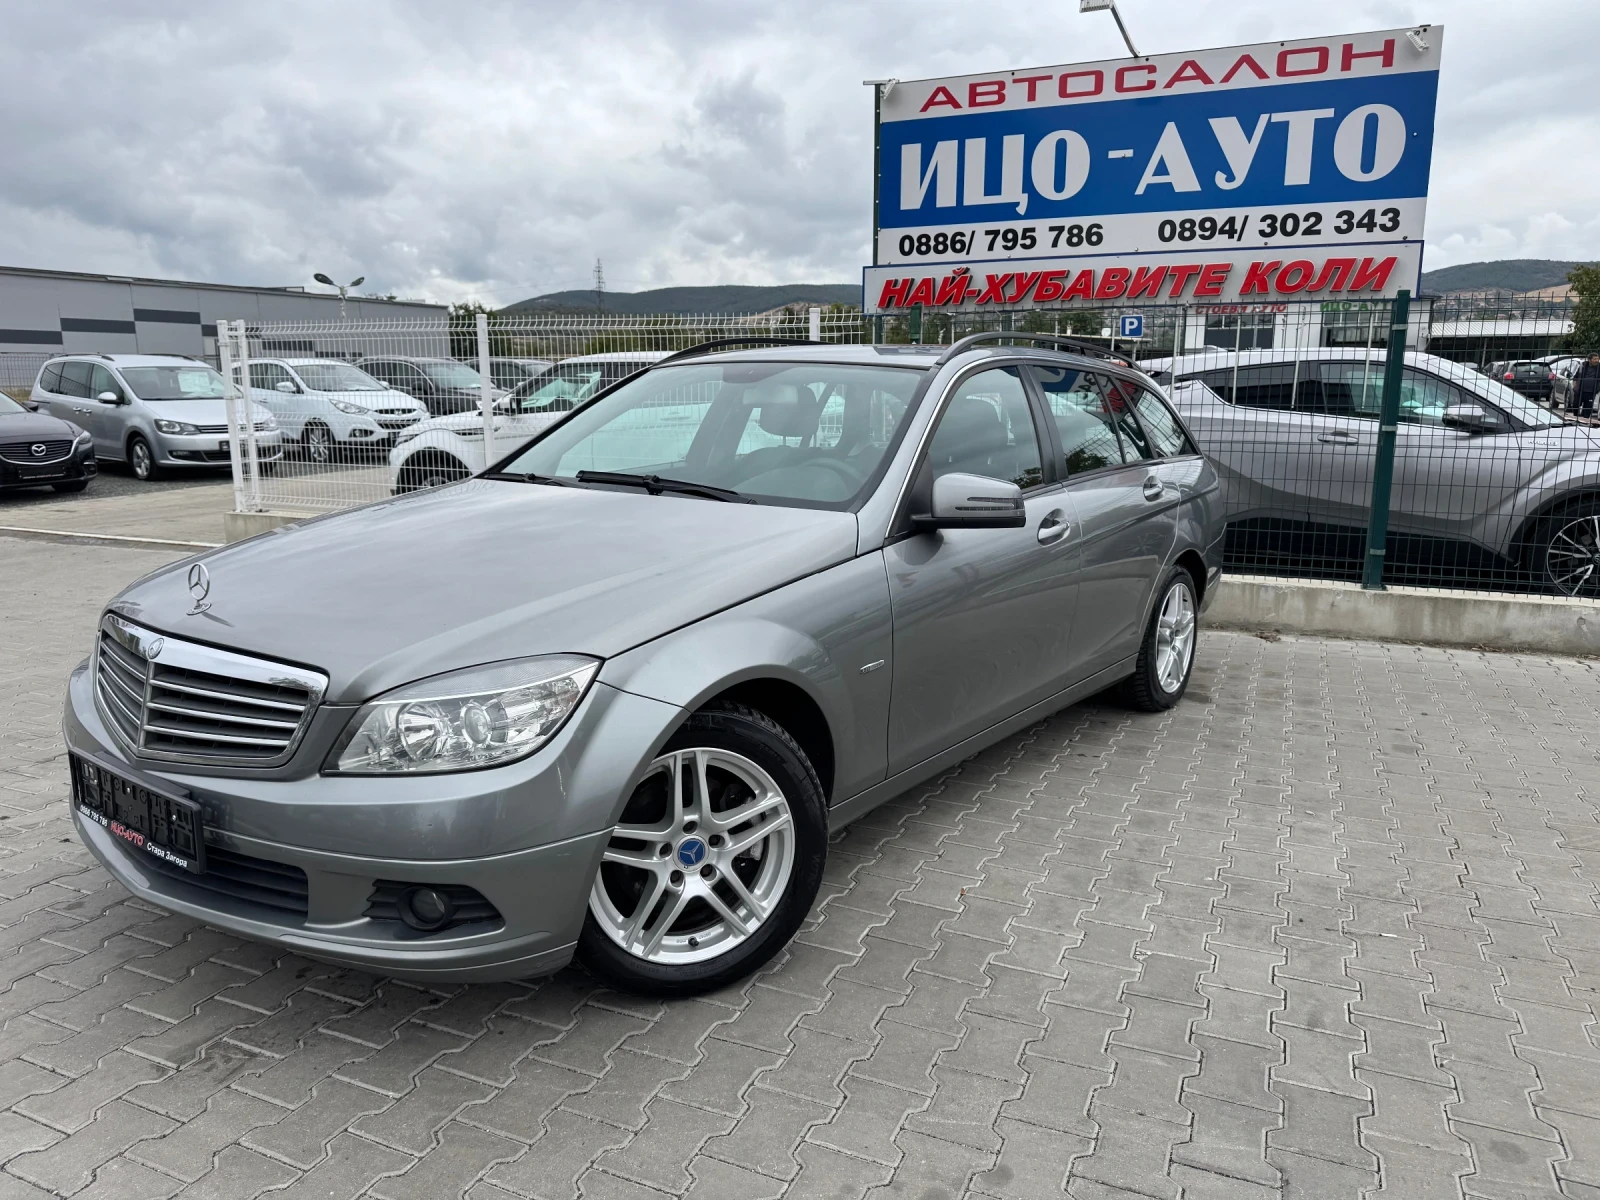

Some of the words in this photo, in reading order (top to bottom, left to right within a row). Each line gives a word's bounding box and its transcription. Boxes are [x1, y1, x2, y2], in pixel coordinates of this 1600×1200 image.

[919, 39, 1395, 113] АВТОСАЛОН
[899, 230, 976, 256] 0886/
[984, 227, 1037, 252] 795
[1048, 223, 1104, 248] 786
[1158, 215, 1249, 242] 0894/
[1258, 212, 1323, 238] 302
[1333, 207, 1401, 235] 343
[877, 262, 1233, 308] НАЙ-ХУБАВИТЕ
[1239, 256, 1399, 296] КОЛИ
[1125, 318, 1138, 334] P
[147, 842, 165, 858] Стара
[165, 851, 188, 868] Загора
